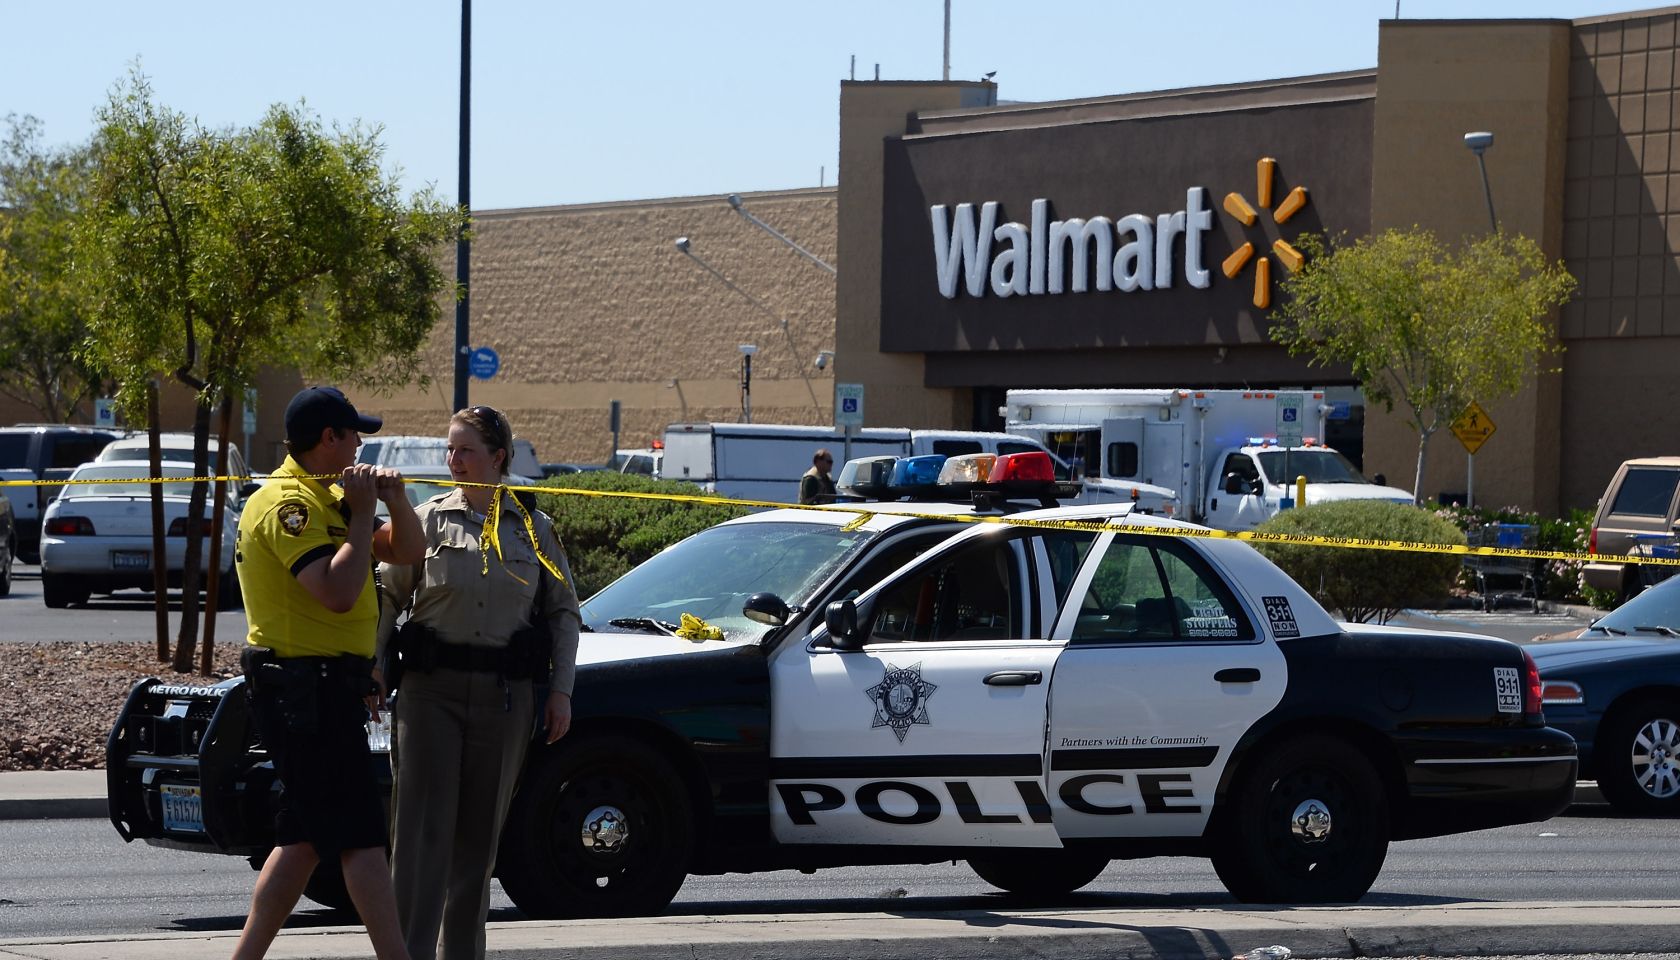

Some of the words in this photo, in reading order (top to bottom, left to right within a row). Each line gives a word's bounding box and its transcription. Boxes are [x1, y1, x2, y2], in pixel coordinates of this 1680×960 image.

[931, 186, 1212, 299] Walmart
[1251, 531, 1281, 540] SCENE
[1186, 618, 1237, 628] STOPPERS
[1273, 622, 1297, 631] NON
[148, 685, 190, 695] METRO
[190, 686, 228, 697] POLIC
[887, 715, 915, 727] POLICE
[1061, 737, 1102, 747] Partners
[1106, 736, 1128, 746] with
[1131, 736, 1147, 746] the
[1150, 734, 1208, 746] Community
[774, 773, 1202, 826] POLICE
